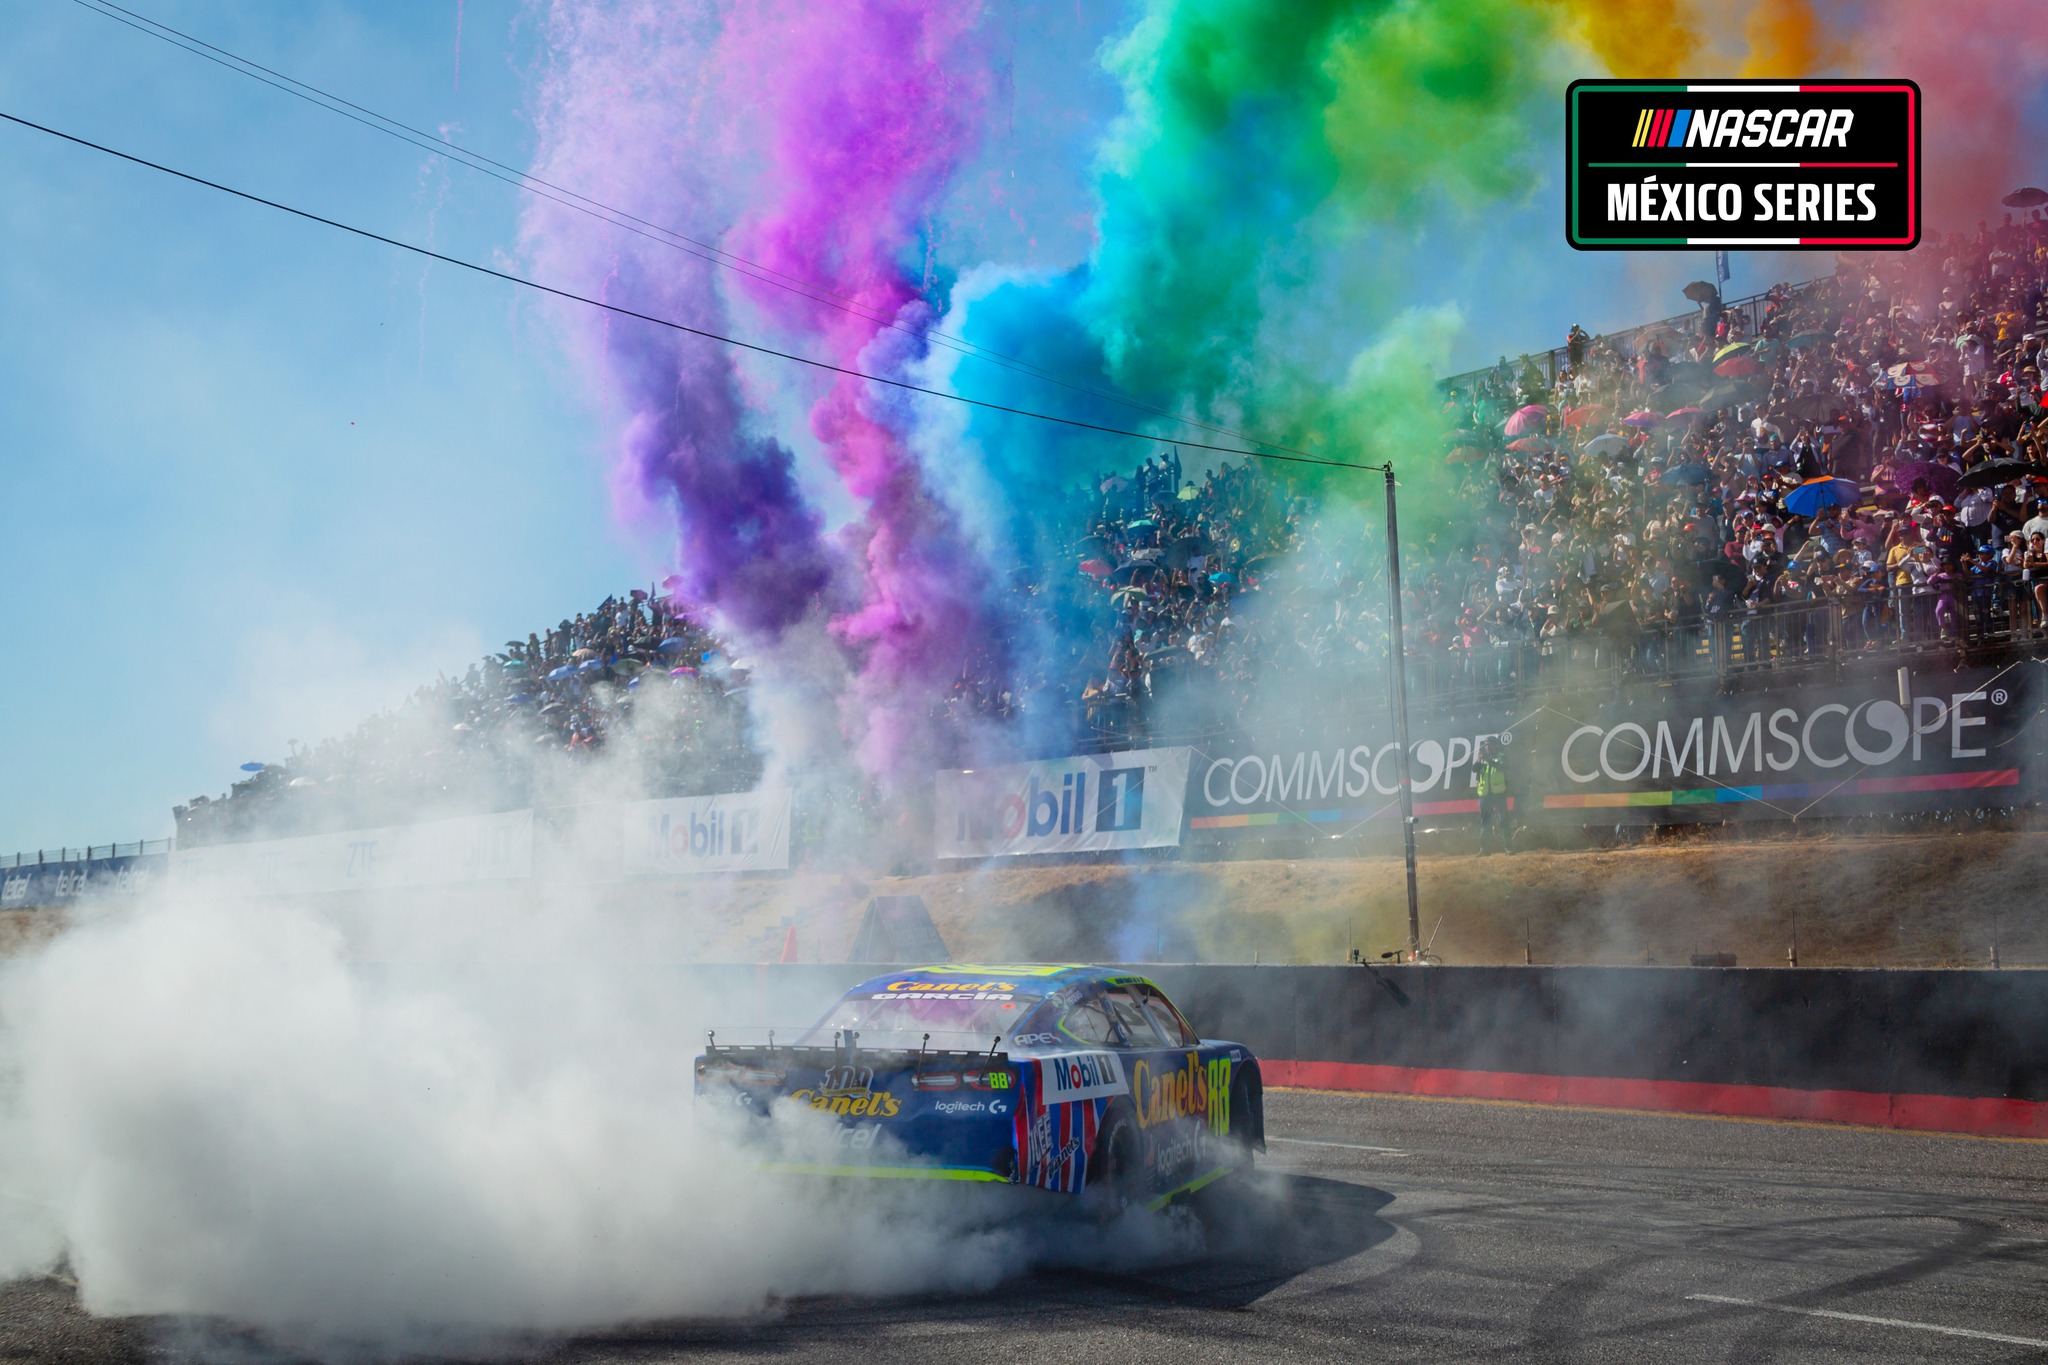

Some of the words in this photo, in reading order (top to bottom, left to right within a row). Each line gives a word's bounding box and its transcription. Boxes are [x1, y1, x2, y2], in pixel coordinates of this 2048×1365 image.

[887, 981, 1019, 991] Canel's
[988, 1072, 1009, 1089] 88
[1055, 1055, 1100, 1091] Mobil
[1134, 1051, 1206, 1129] Canel's
[1208, 1058, 1231, 1137] 88
[935, 1100, 985, 1114] logitech
